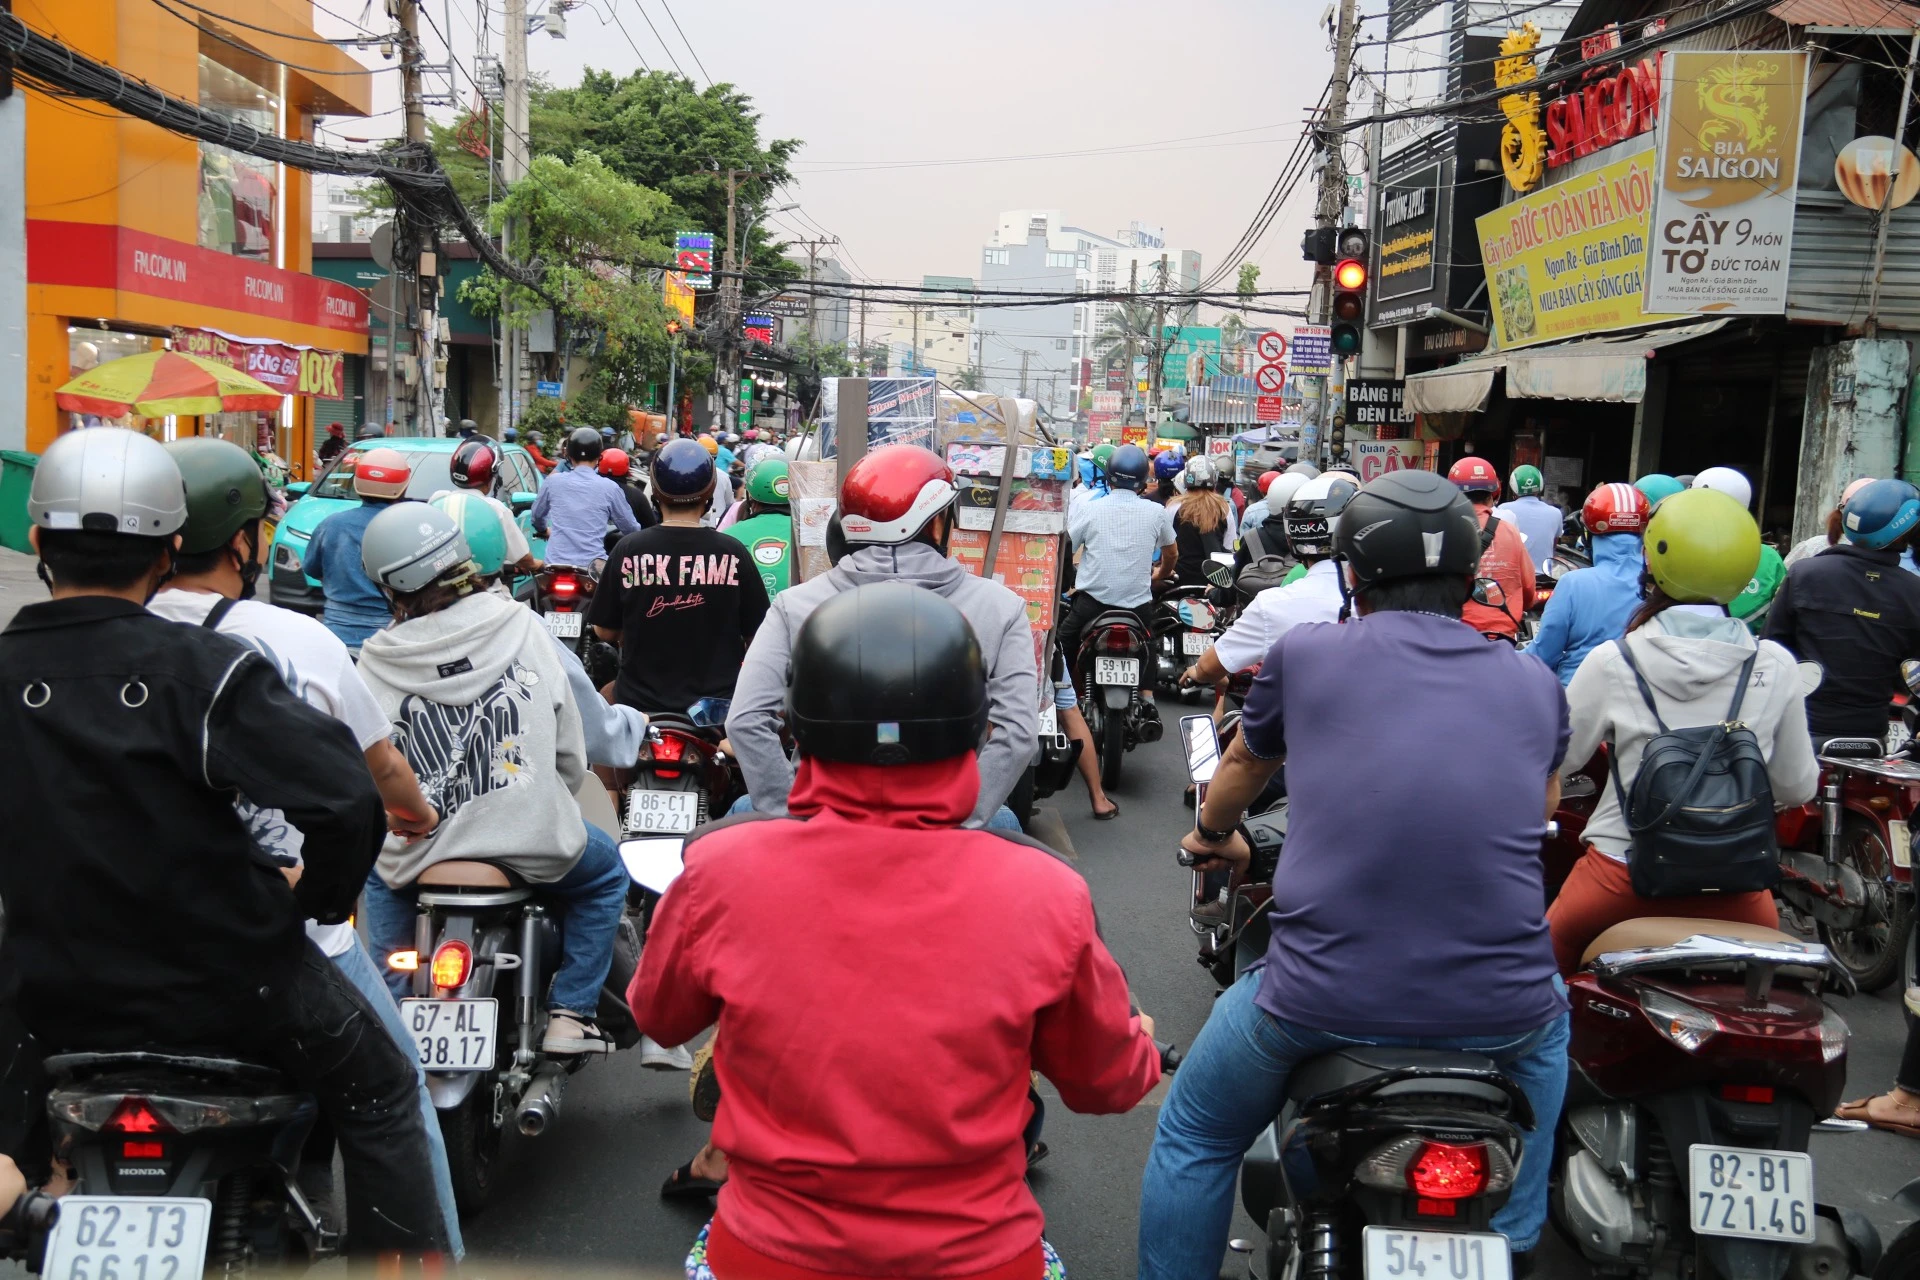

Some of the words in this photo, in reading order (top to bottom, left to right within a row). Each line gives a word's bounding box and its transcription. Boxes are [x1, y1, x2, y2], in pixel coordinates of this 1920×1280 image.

[1547, 50, 1662, 168] SAIGON
[1714, 141, 1745, 156] BIA
[1676, 155, 1779, 179] SAIGON
[1510, 203, 1543, 252] ĐỨC
[1541, 189, 1588, 241] TOÀN
[1588, 175, 1616, 228] HÀ
[1614, 163, 1652, 223] NỘI
[1664, 211, 1730, 245] CẦY
[1735, 218, 1753, 246] 9
[1751, 232, 1783, 246] MÓN
[679, 235, 711, 249] QUÁN
[1544, 254, 1566, 280] Ngon
[1583, 244, 1599, 266] Giá
[1600, 237, 1620, 263] Bình
[1623, 232, 1643, 258] Dân
[1662, 248, 1709, 274] TƠ
[1711, 256, 1741, 271] ĐỨC
[1744, 258, 1781, 271] TOÀN
[133, 250, 187, 283] FM.COM.VN
[244, 276, 284, 304] FM.COM.VN
[1538, 290, 1559, 312] MUA
[1559, 284, 1577, 308] BÁN
[1577, 273, 1596, 304] CẦY
[1596, 269, 1623, 300] SỐNG
[1623, 264, 1642, 294] GIÁ
[1680, 276, 1698, 285] Ngon
[1716, 286, 1737, 294] SỐNG
[1738, 286, 1751, 294] GIÁ
[326, 296, 356, 319] FM.COM.VN
[789, 299, 808, 309] TẤM
[1424, 335, 1435, 350] THU
[299, 350, 339, 397] 10K
[1350, 382, 1388, 402] BẢNG
[1837, 378, 1850, 392] 71
[867, 400, 897, 416] Citrus
[898, 386, 933, 404] Master
[1357, 404, 1386, 422] ĐÈN
[896, 428, 930, 443] Master
[1360, 443, 1385, 453] Quán
[1891, 507, 1917, 529] UBER
[1288, 522, 1326, 534] CASKA
[620, 553, 671, 589] SICK
[678, 553, 740, 586] FAME
[550, 613, 575, 625] 75-D1
[1853, 607, 1880, 619] hummel
[1187, 633, 1210, 645] 59-T2
[1102, 659, 1132, 671] 59-V1
[1098, 671, 1137, 684] 151.03
[641, 794, 686, 811] 86-C1
[633, 812, 691, 831] 962.21
[412, 1003, 481, 1033] 67-AL
[1740, 1005, 1800, 1017] HONDA
[1435, 1132, 1475, 1141] HONDA
[118, 1167, 166, 1176] HONDA
[1709, 1153, 1790, 1194] 82-B1
[1699, 1190, 1807, 1236] 721.46
[76, 1204, 187, 1249] 62-T3
[1385, 1234, 1484, 1280] 54-U1
